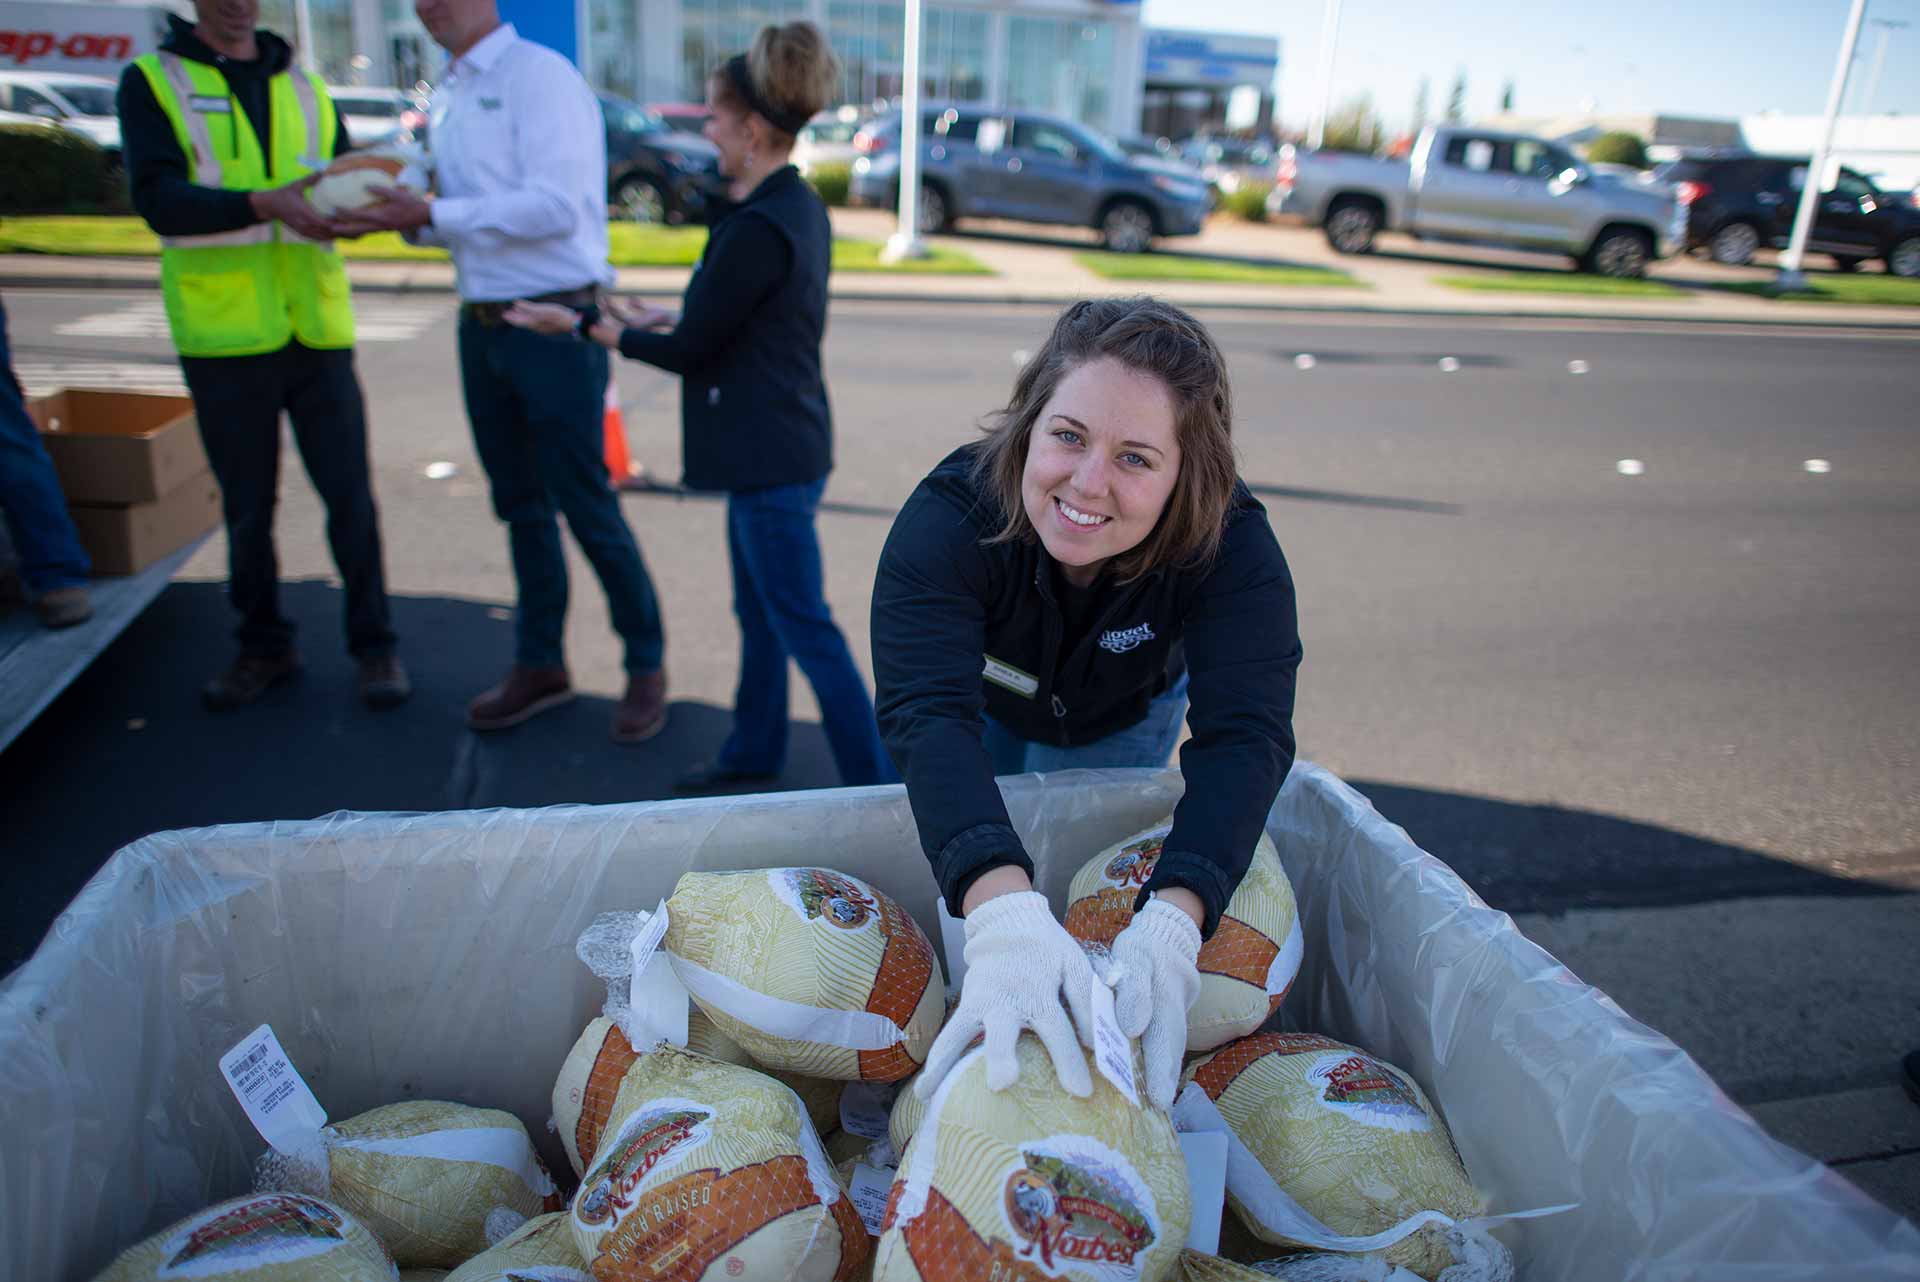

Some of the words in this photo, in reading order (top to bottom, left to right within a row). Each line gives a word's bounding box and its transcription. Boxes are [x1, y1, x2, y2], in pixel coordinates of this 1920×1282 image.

[606, 1120, 695, 1228] Norbest
[609, 1215, 649, 1265] RANCH
[652, 1186, 710, 1223] RAISED
[1019, 1217, 1138, 1270] Norbest
